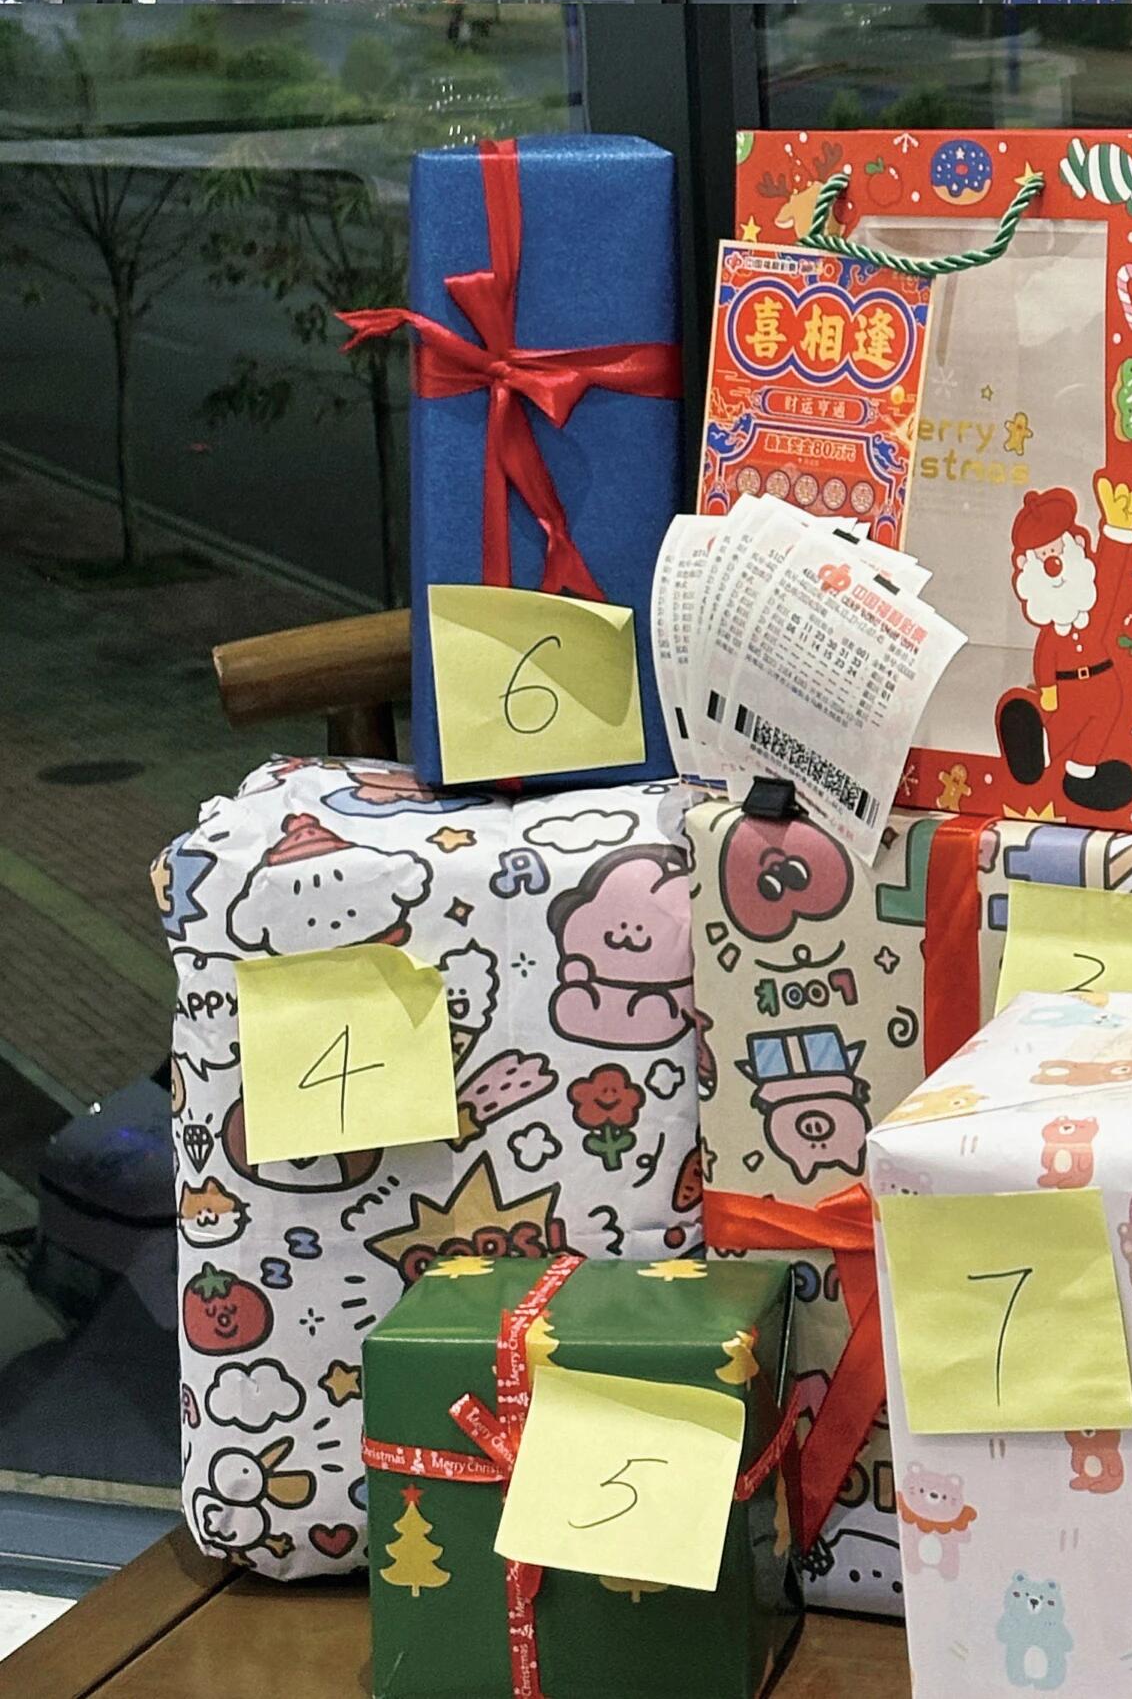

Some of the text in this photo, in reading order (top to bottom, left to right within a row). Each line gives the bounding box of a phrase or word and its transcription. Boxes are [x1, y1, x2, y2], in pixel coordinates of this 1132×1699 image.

[745, 296, 896, 371] 喜相逢
[913, 448, 1031, 485] stmas
[918, 419, 995, 454] erry
[499, 635, 561, 734] 6
[174, 990, 239, 1021] APPY
[299, 1024, 385, 1134] 4
[967, 1267, 1034, 1408] 7
[431, 1453, 466, 1475] Merry
[568, 1458, 669, 1530] 5
